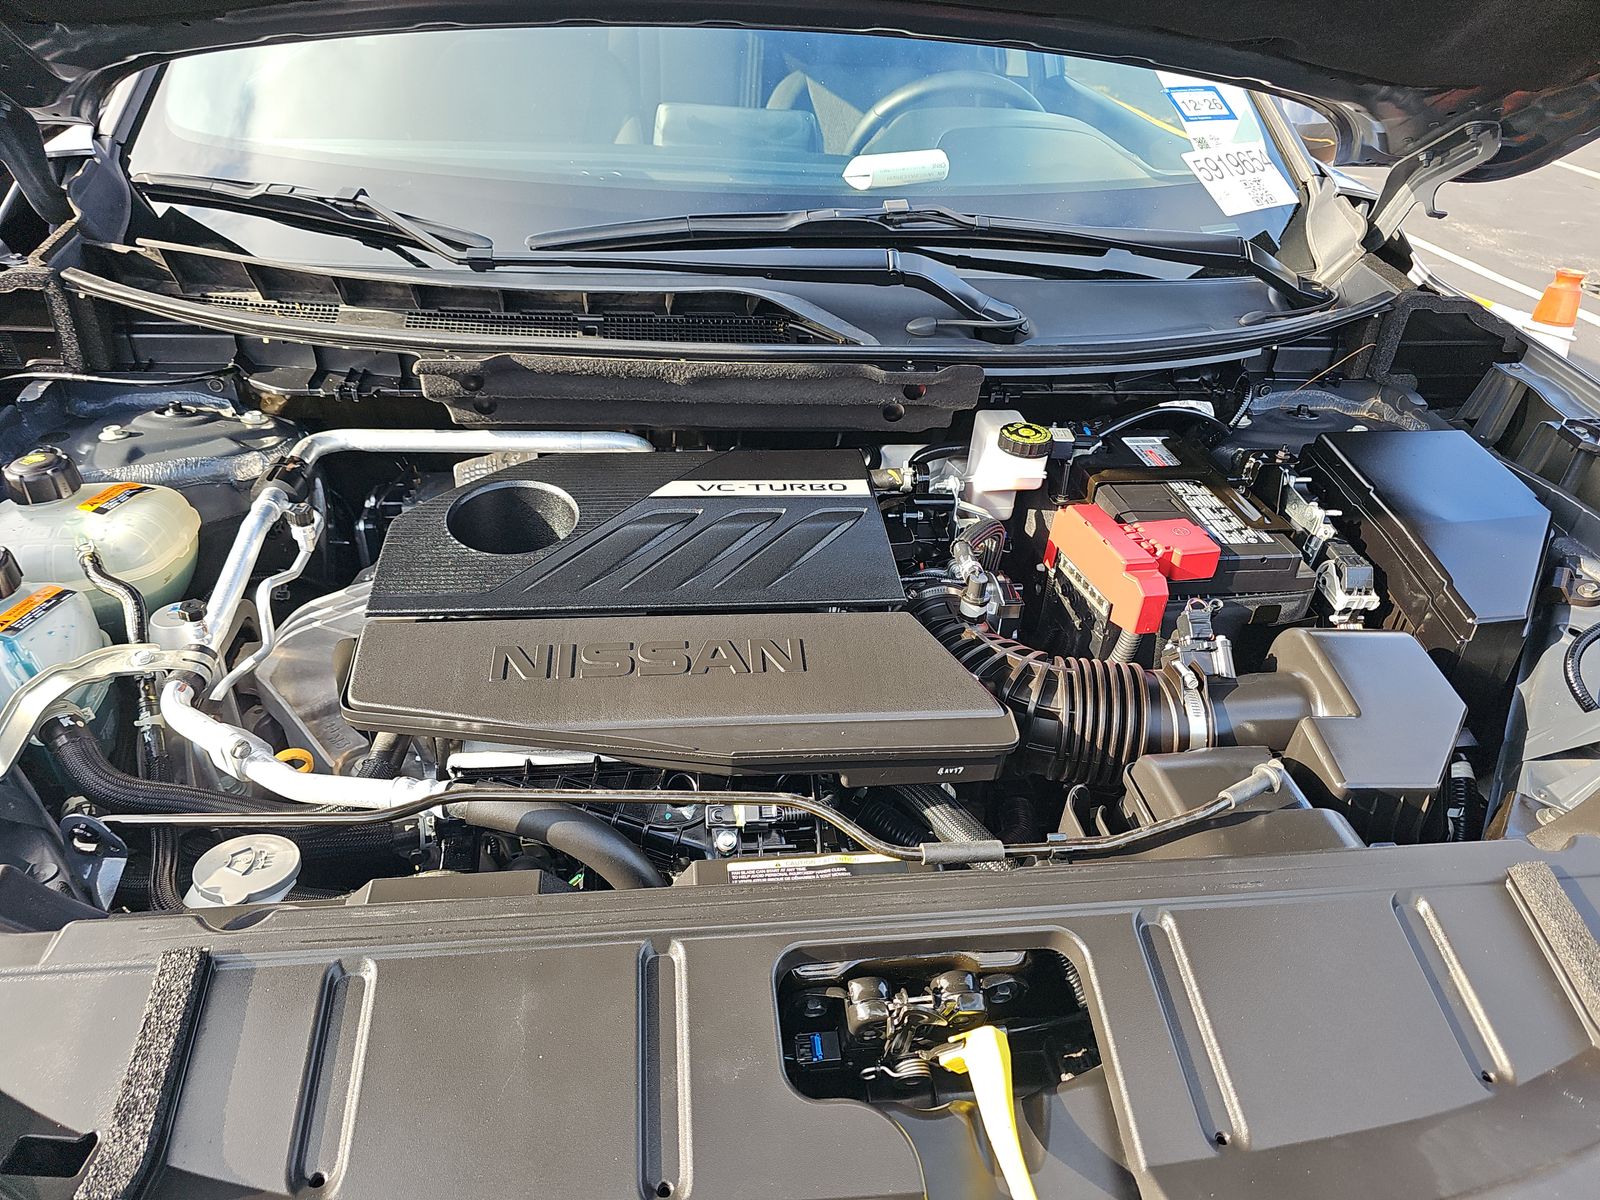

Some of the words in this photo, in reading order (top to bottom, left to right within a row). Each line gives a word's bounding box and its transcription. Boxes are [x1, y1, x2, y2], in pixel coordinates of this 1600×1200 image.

[1193, 149, 1274, 182] 5919654
[696, 483, 848, 492] VC-TURBO
[489, 638, 807, 682] NISSAN
